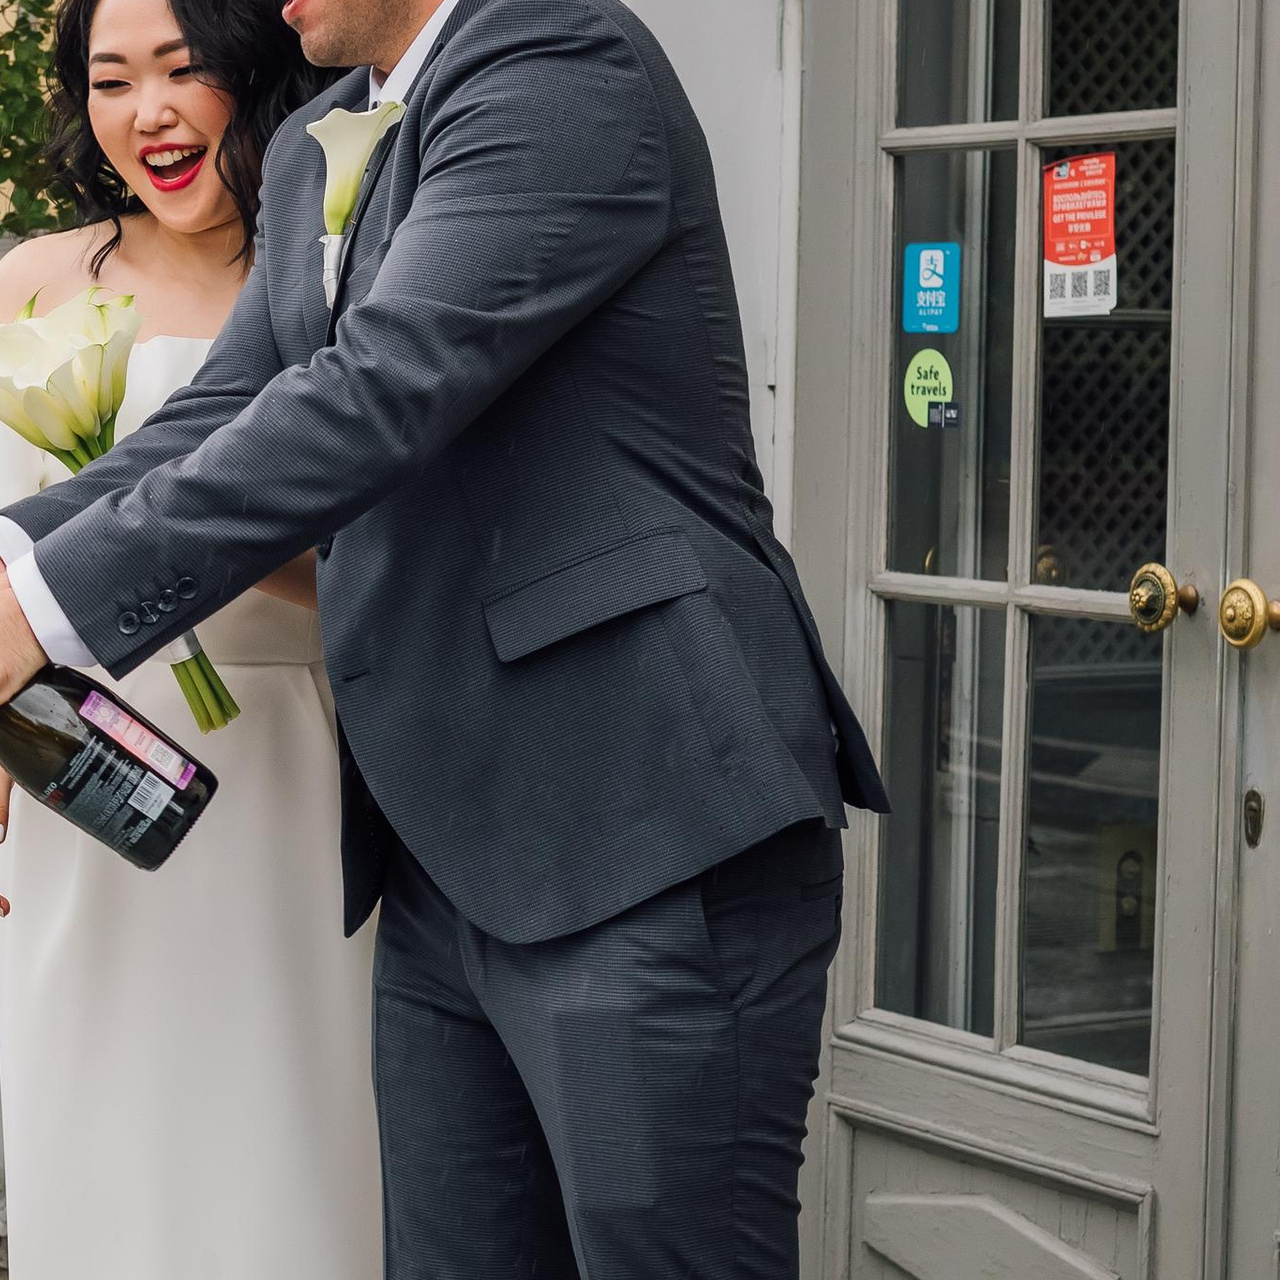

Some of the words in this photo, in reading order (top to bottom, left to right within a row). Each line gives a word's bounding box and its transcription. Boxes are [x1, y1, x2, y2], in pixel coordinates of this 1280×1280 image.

[916, 290, 946, 308] 支付宝
[918, 308, 943, 316] ALIPAY
[917, 365, 939, 380] Safe
[910, 381, 947, 396] travels
